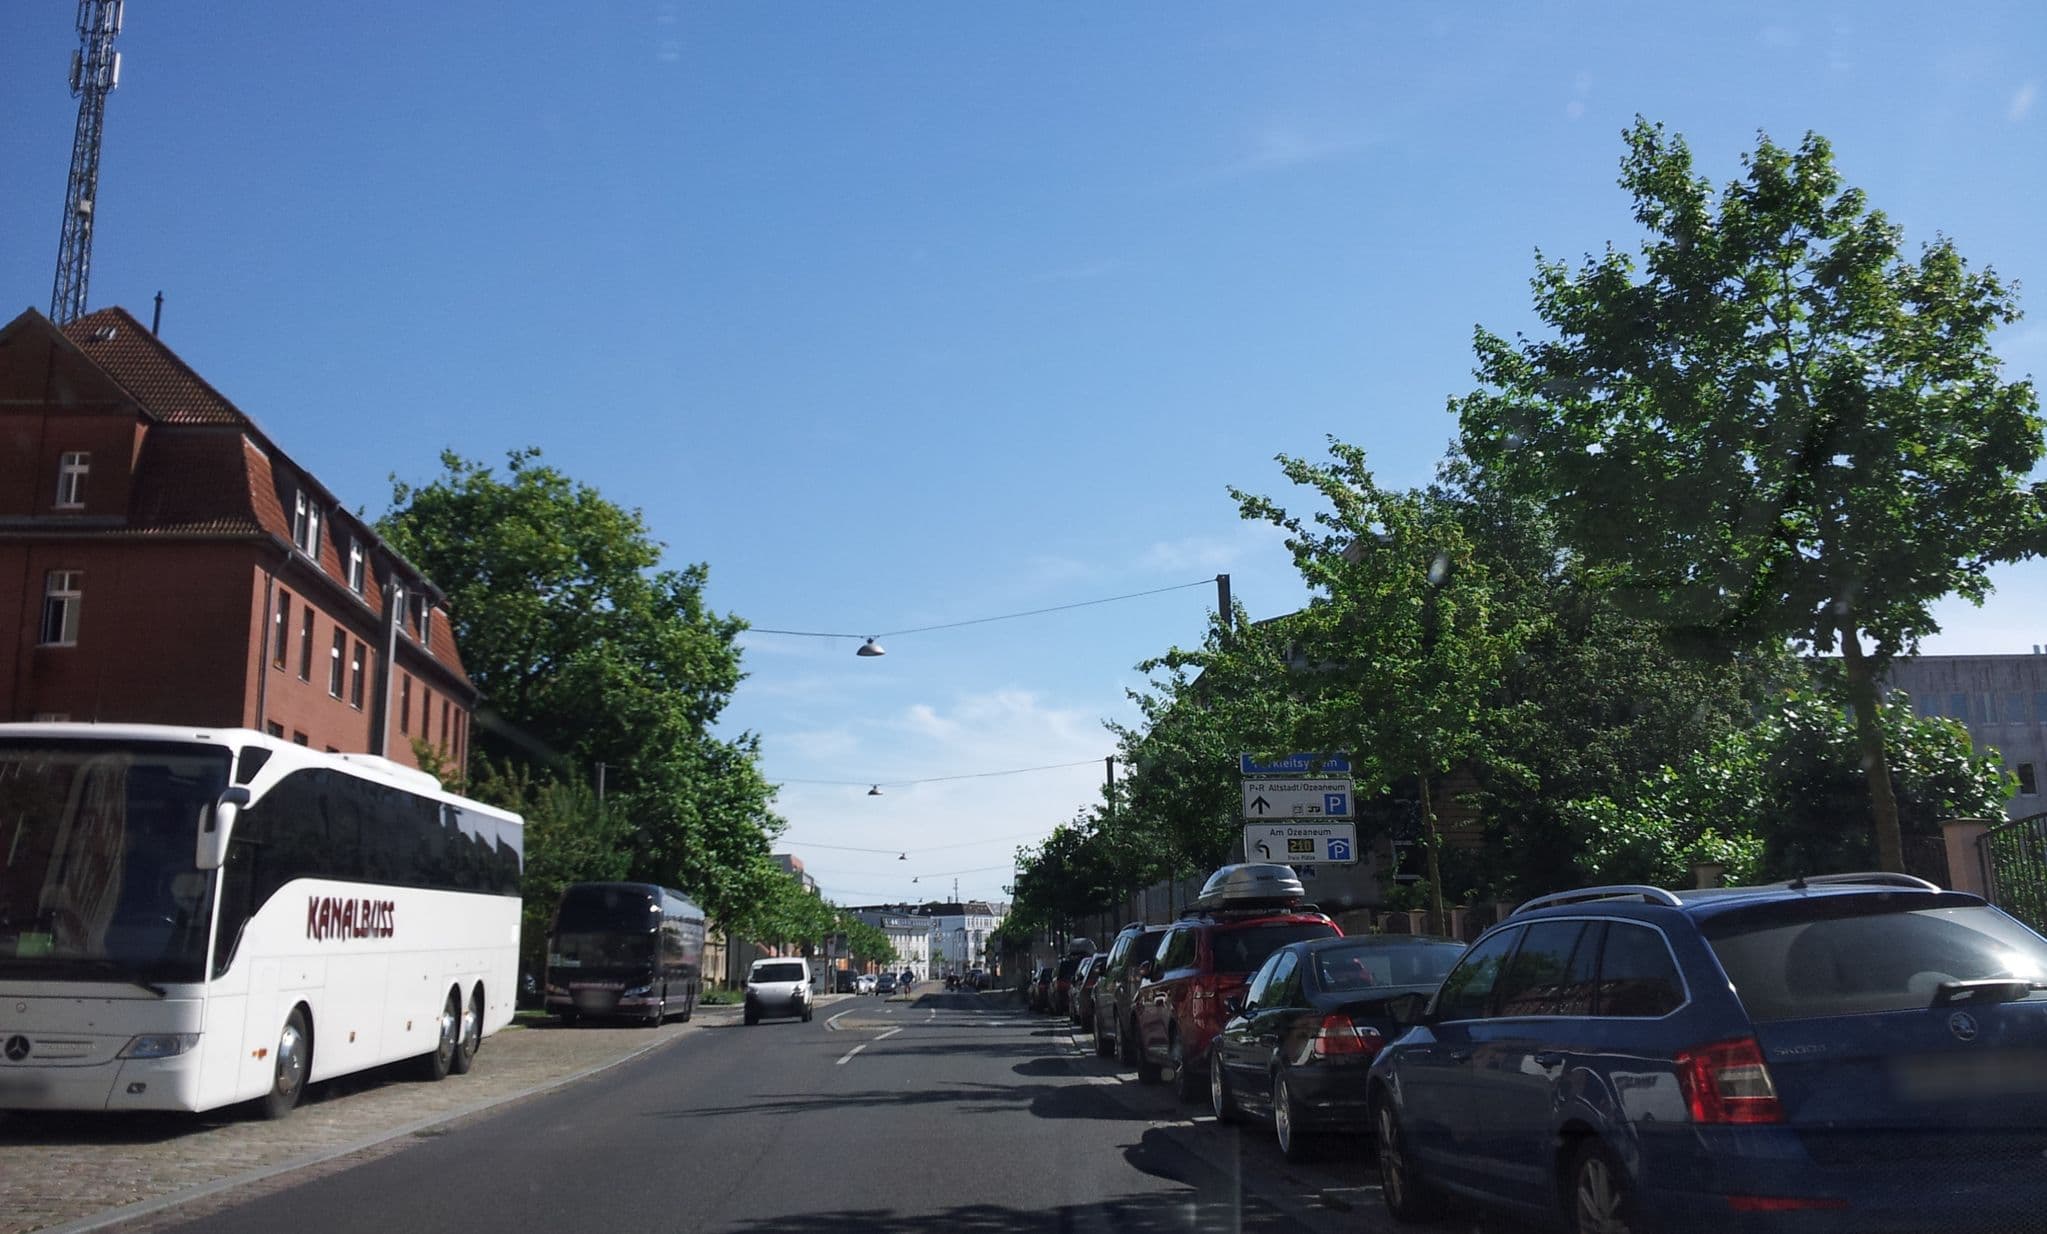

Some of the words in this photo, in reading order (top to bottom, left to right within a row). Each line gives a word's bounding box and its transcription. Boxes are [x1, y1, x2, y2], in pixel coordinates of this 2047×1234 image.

[1330, 797, 1341, 812] P
[1287, 828, 1331, 836] Ozeaneum
[1334, 846, 1344, 858] P
[306, 896, 395, 942] KANALBUSS
